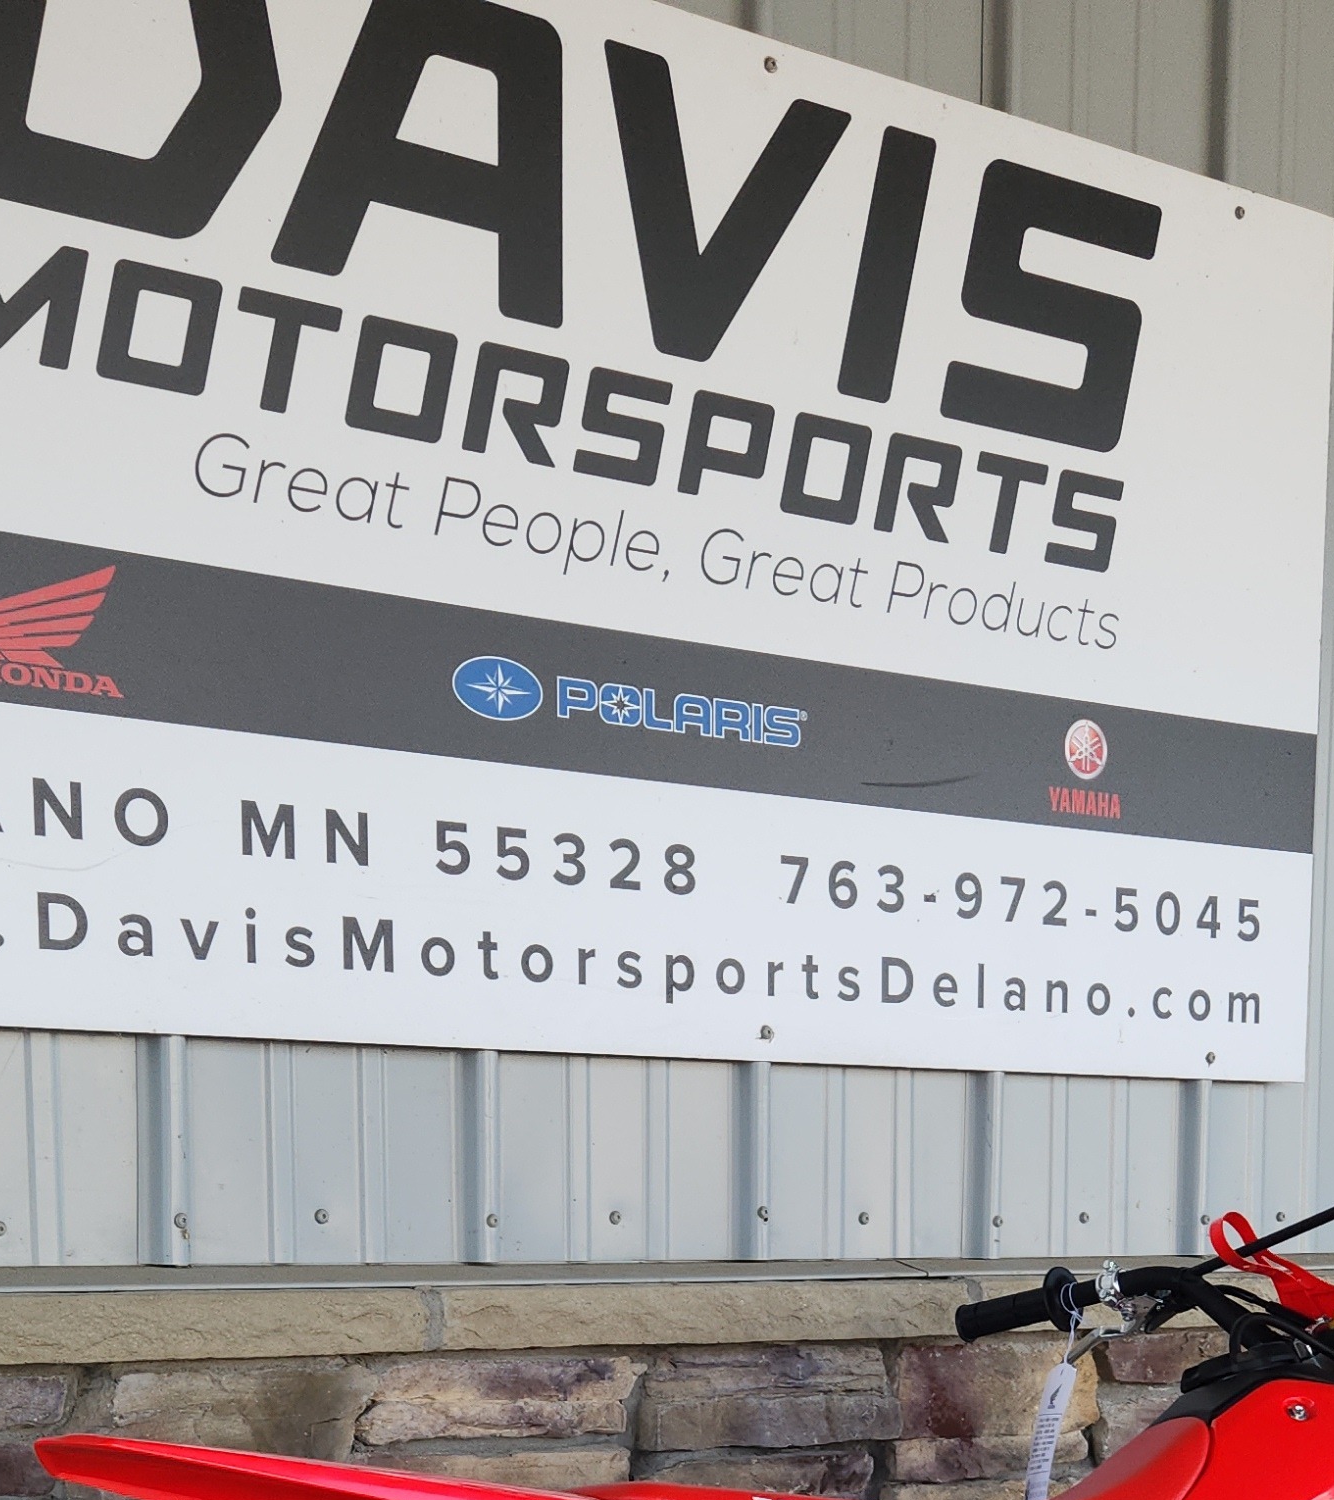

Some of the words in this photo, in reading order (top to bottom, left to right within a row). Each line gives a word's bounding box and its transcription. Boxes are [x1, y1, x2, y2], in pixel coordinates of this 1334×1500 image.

[195, 433, 410, 530] Great
[434, 476, 670, 582] People,
[701, 528, 869, 609] Great
[887, 560, 1120, 650] Products
[557, 676, 802, 748] POLARIS
[1048, 786, 1121, 819] YAMAHA
[241, 800, 369, 866] MN
[436, 820, 696, 895] 55328
[781, 854, 1260, 942] 763-972-5045
